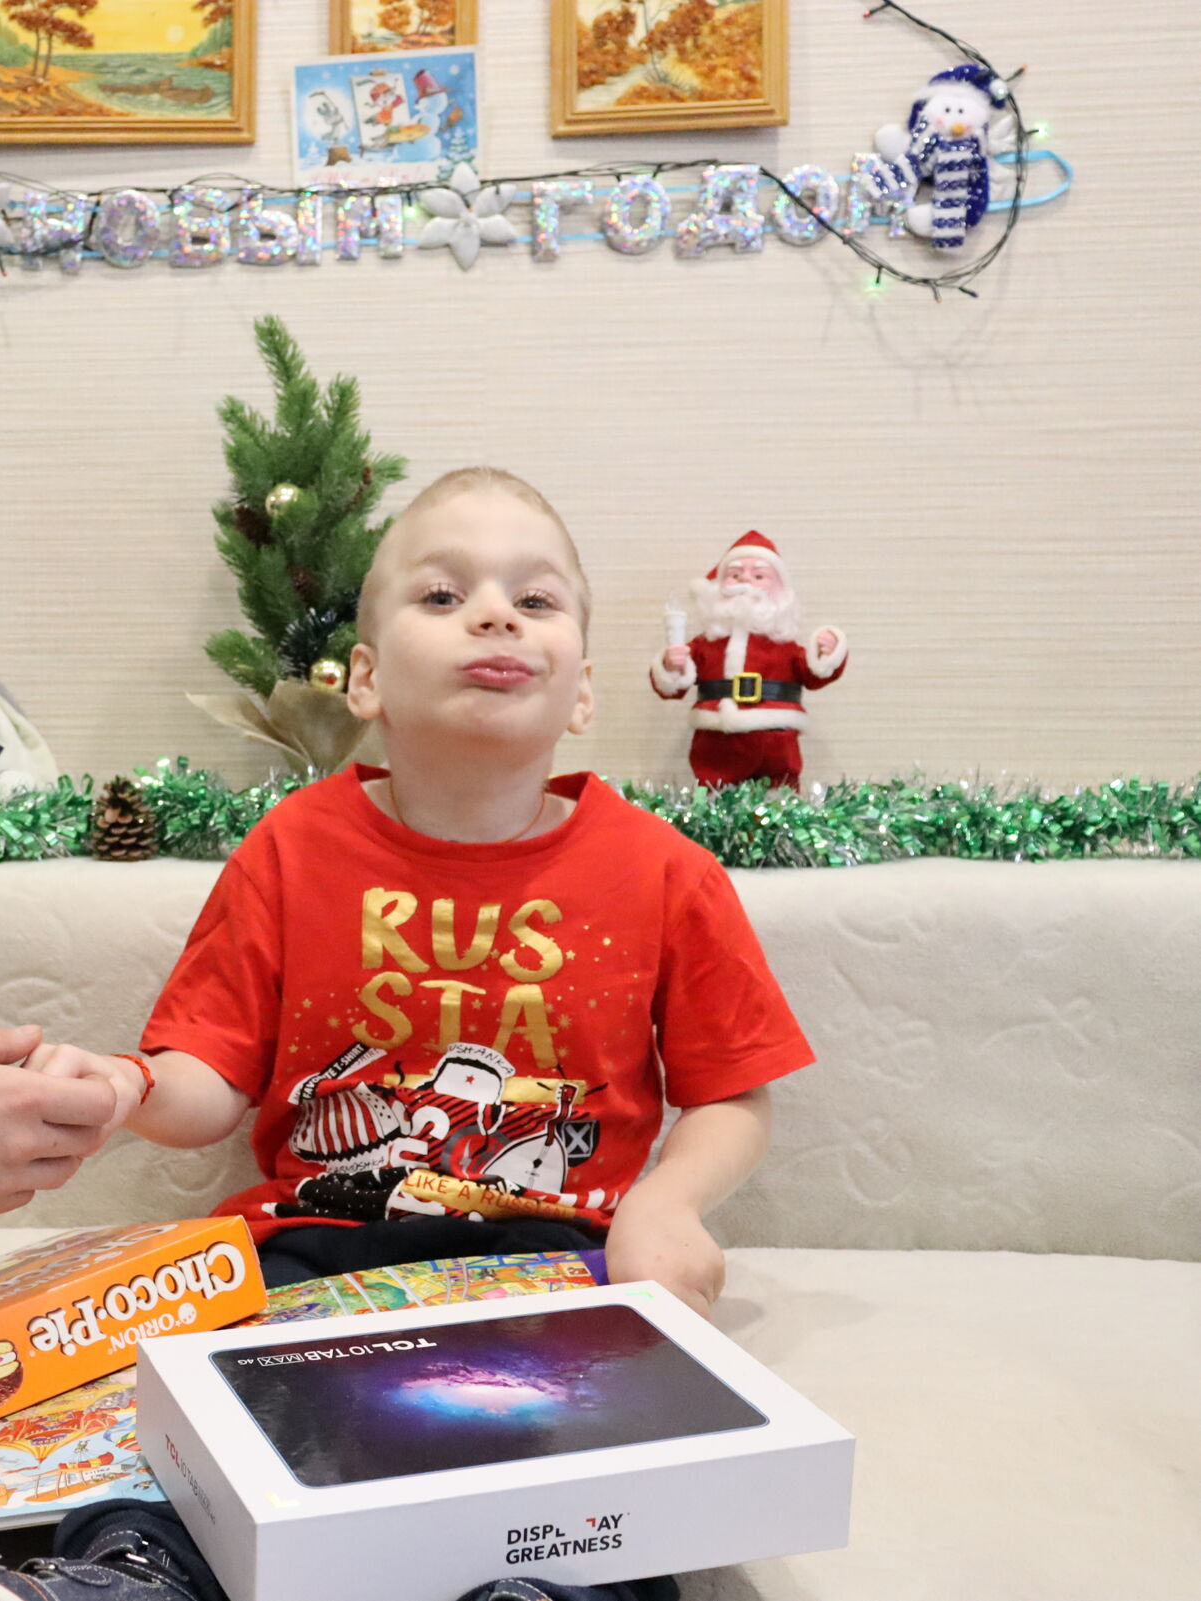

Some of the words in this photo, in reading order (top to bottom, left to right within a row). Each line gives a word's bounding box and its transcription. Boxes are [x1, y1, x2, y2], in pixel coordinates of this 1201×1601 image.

[361, 887, 564, 983] RUS
[303, 1067, 338, 1099] FAVOTE
[333, 1043, 365, 1071] T-SHIRT
[404, 1174, 452, 1195] LIKE
[457, 1184, 472, 1200] A
[111, 1313, 175, 1352] ORION
[372, 1338, 438, 1352] TCL
[238, 1358, 254, 1366] 4G
[260, 1353, 303, 1366] MAX
[304, 1349, 350, 1361] TAB
[349, 1345, 374, 1355] 10
[165, 1434, 180, 1469] TCL
[505, 1534, 623, 1564] GREATNESS
